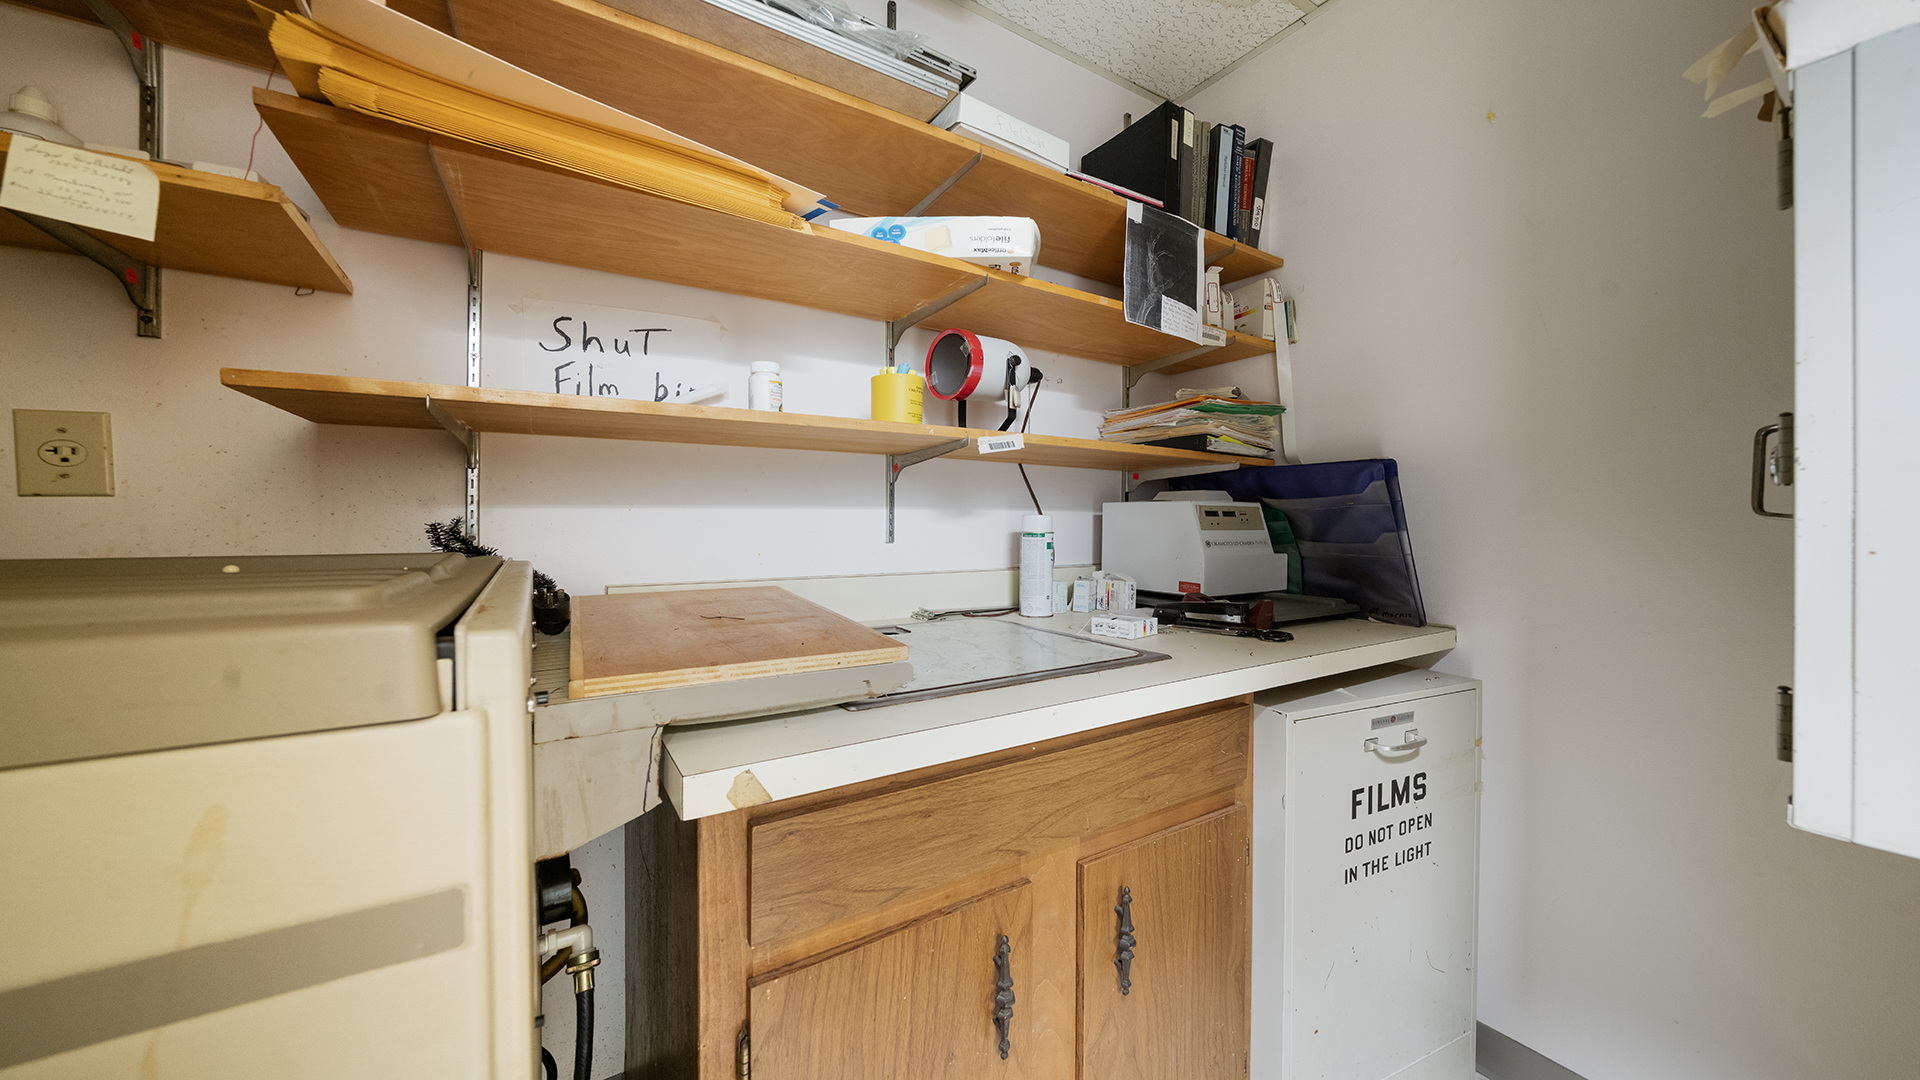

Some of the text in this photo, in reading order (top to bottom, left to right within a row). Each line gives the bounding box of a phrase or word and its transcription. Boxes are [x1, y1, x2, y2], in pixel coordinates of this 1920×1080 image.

[554, 360, 696, 403] Film bi
[1351, 771, 1427, 820] FILMS
[1345, 812, 1433, 854] DO NOT OPEN
[1344, 841, 1432, 885] IN THE LIGHT
